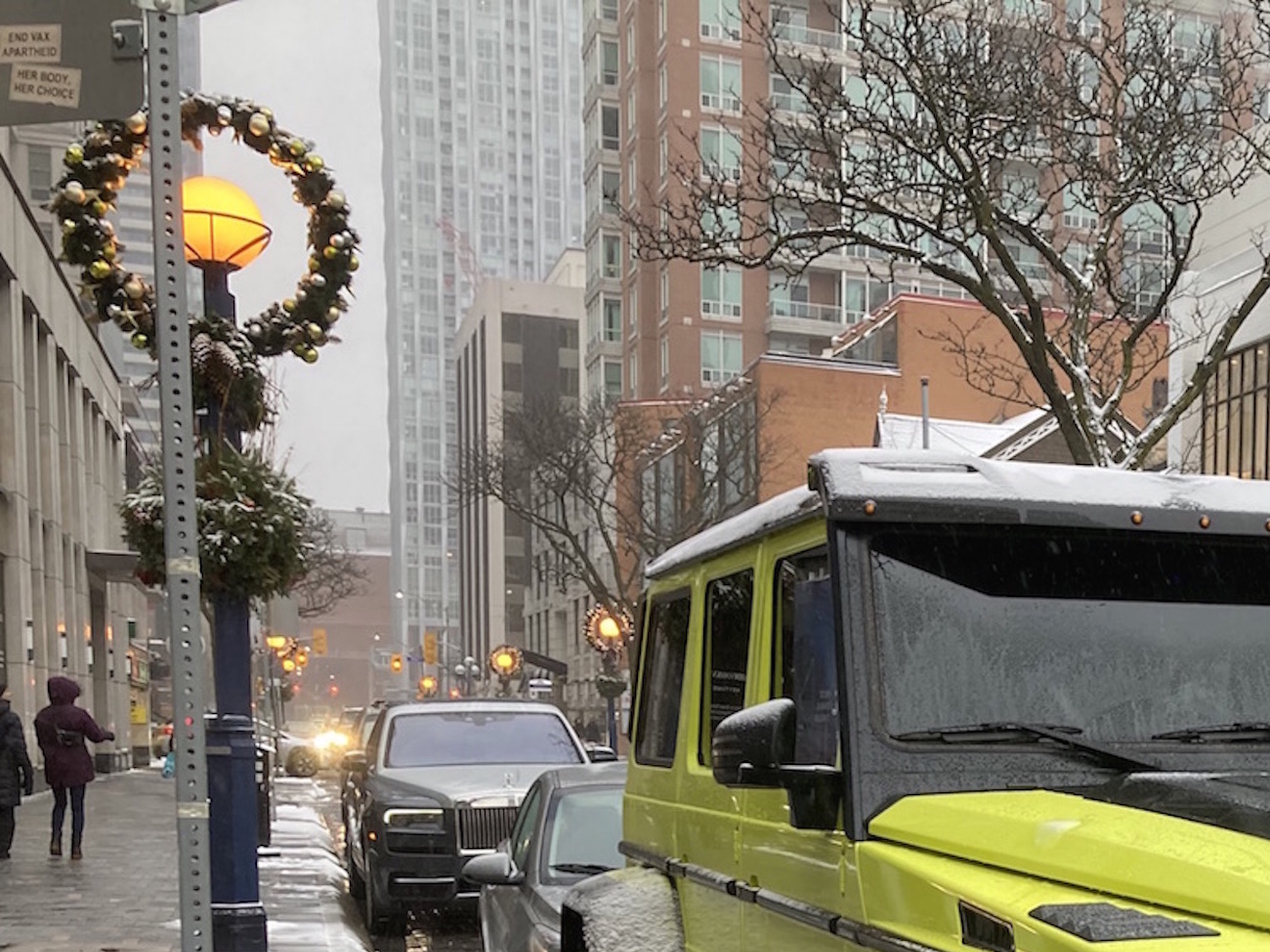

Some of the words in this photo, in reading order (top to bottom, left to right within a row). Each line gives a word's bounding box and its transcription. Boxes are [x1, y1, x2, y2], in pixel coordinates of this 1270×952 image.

[8, 32, 28, 43] END
[30, 31, 50, 41] VAX
[2, 46, 57, 57] APARTHEID
[17, 69, 38, 81] HER
[14, 82, 34, 94] HER
[36, 85, 75, 100] CHOICE
